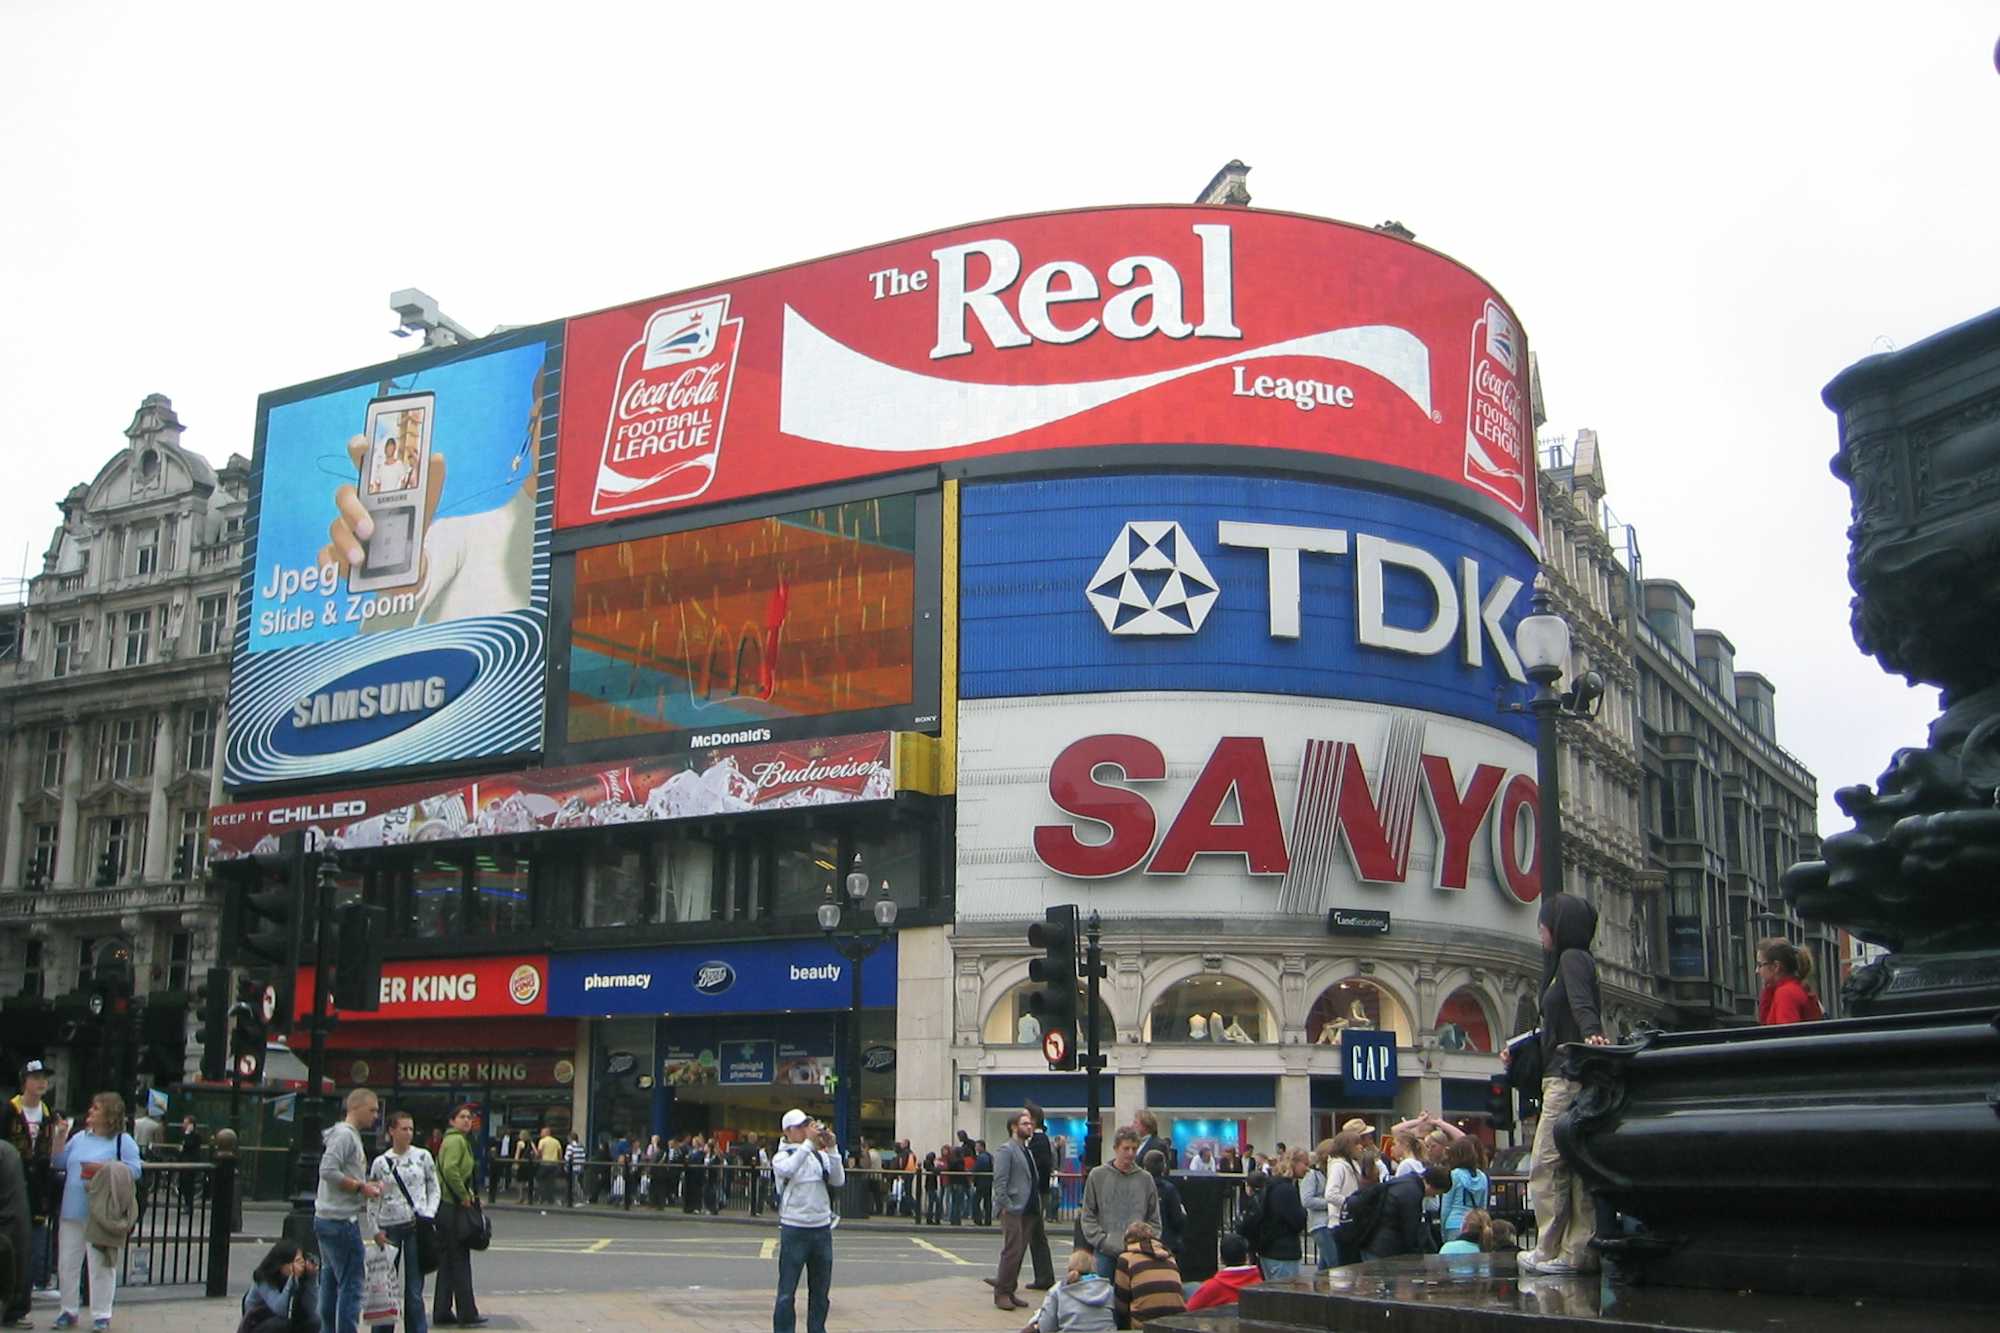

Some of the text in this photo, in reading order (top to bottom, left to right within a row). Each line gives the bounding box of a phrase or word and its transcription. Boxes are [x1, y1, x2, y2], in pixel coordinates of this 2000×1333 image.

[870, 224, 1243, 361] The Real
[619, 361, 726, 420] Coca-Cola
[1231, 366, 1355, 412] League
[617, 408, 713, 442] FOOTBALL
[1475, 413, 1521, 465] LEAGUE
[1476, 398, 1521, 446] FOOTBALL
[612, 423, 712, 463] LEAGUE
[261, 557, 341, 604] Jpeg
[258, 592, 415, 637] Slide & Zoom
[1217, 520, 1528, 685] TDK
[291, 675, 447, 729] SAMSUNG
[914, 714, 937, 724] SONY
[690, 728, 771, 749] McDonald's
[751, 757, 884, 789] Budweiser
[212, 799, 367, 826] KEEP IT CHILLED
[1033, 722, 1543, 905] SANYO
[412, 973, 477, 1002] KING
[584, 972, 651, 991] pharmacy
[789, 963, 841, 982] beauty
[397, 1062, 528, 1081] BURGER KING
[1352, 1044, 1389, 1082] GAP
